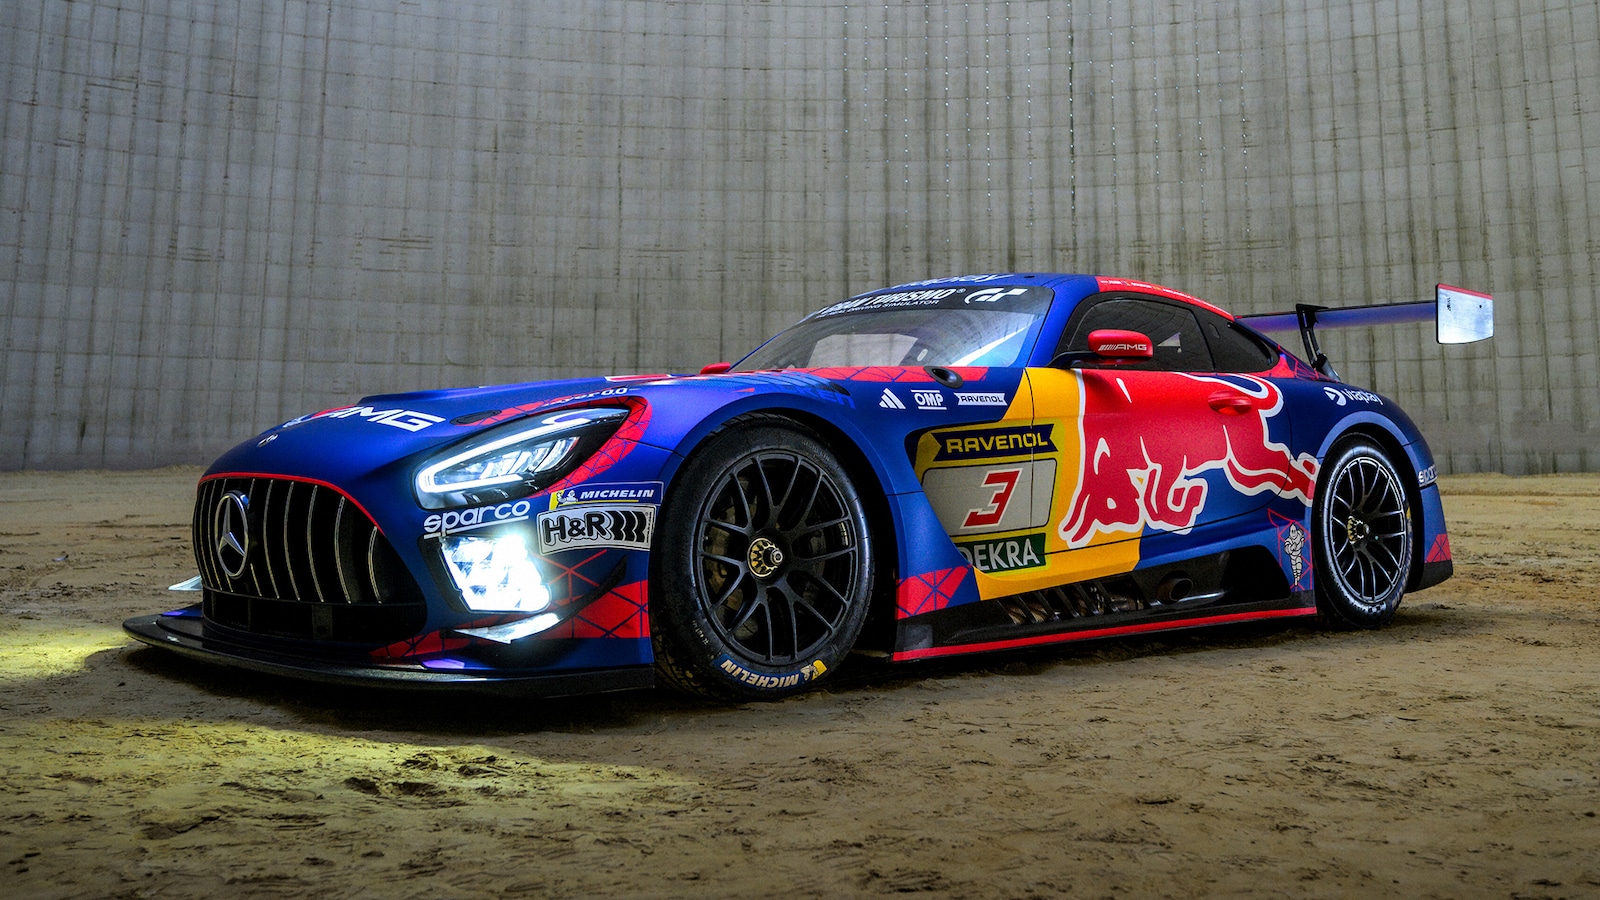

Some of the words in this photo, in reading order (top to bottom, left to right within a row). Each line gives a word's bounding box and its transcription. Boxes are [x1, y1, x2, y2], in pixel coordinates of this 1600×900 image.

[882, 300, 939, 308] SIMULATOR
[914, 392, 944, 407] OMP
[959, 395, 1004, 403] RAVENOL
[1341, 388, 1384, 406] viaplay
[946, 432, 1049, 454] RAVENOL
[580, 489, 654, 499] MICHELIN
[960, 467, 1023, 529] 3
[423, 500, 531, 537] sparco
[542, 511, 612, 545] H&R
[720, 659, 800, 688] MICHELIN
